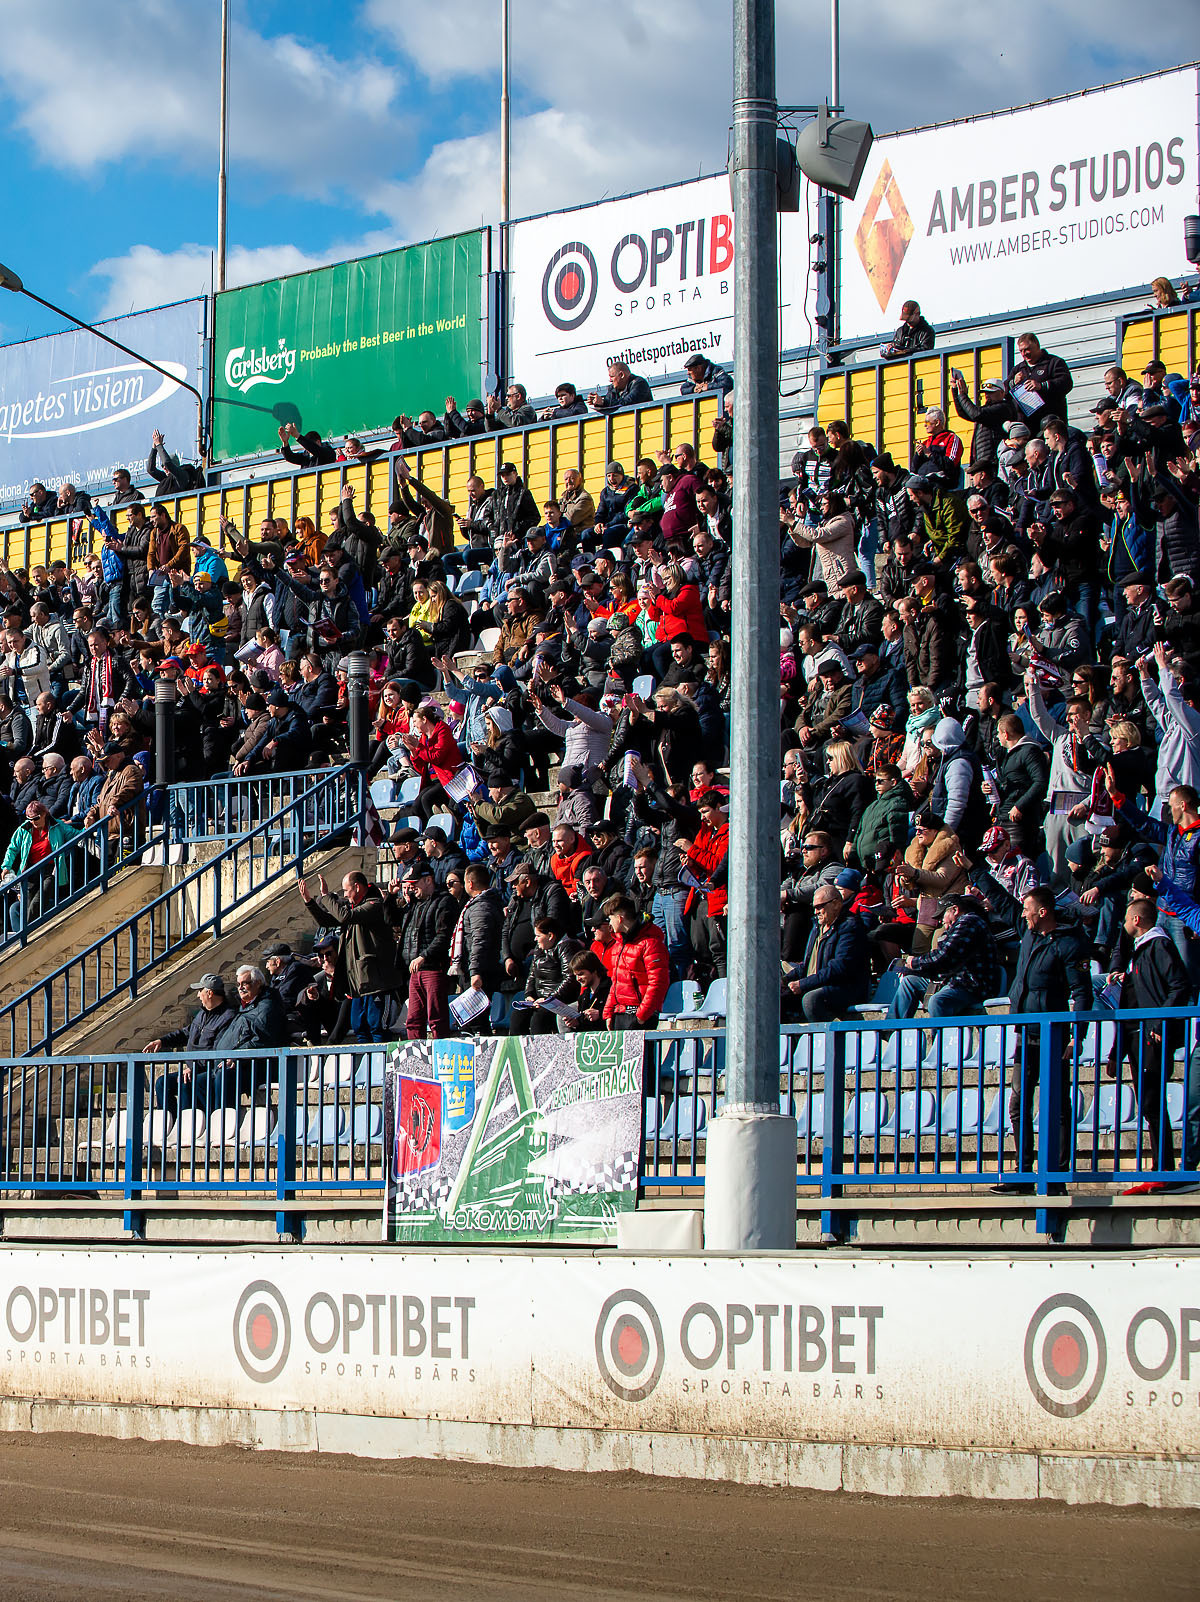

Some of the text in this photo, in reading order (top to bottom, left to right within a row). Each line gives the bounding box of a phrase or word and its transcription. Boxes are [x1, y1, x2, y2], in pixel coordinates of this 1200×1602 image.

[926, 137, 1185, 236] AMBER STUDIOS
[950, 205, 1164, 266] WWW.AMBER-STUDIOS.COM
[614, 287, 701, 316] SPORTA
[225, 314, 466, 390] Carlsberg Probably the Best Beer in the World
[73, 375, 144, 416] visiem
[581, 1031, 618, 1065] 52
[598, 1060, 638, 1099] TRACK
[443, 1209, 551, 1230] LOKOMOTIV
[6, 1286, 150, 1347] OPTIBET
[304, 1292, 476, 1359] OPTIBET
[680, 1302, 884, 1374] OPTIBET
[6, 1350, 152, 1368] SPORTA BĀRS
[305, 1361, 476, 1382] SPORTA BĀRS
[682, 1378, 884, 1400] SPORTA BĀRS
[1126, 1391, 1200, 1408] SPO
